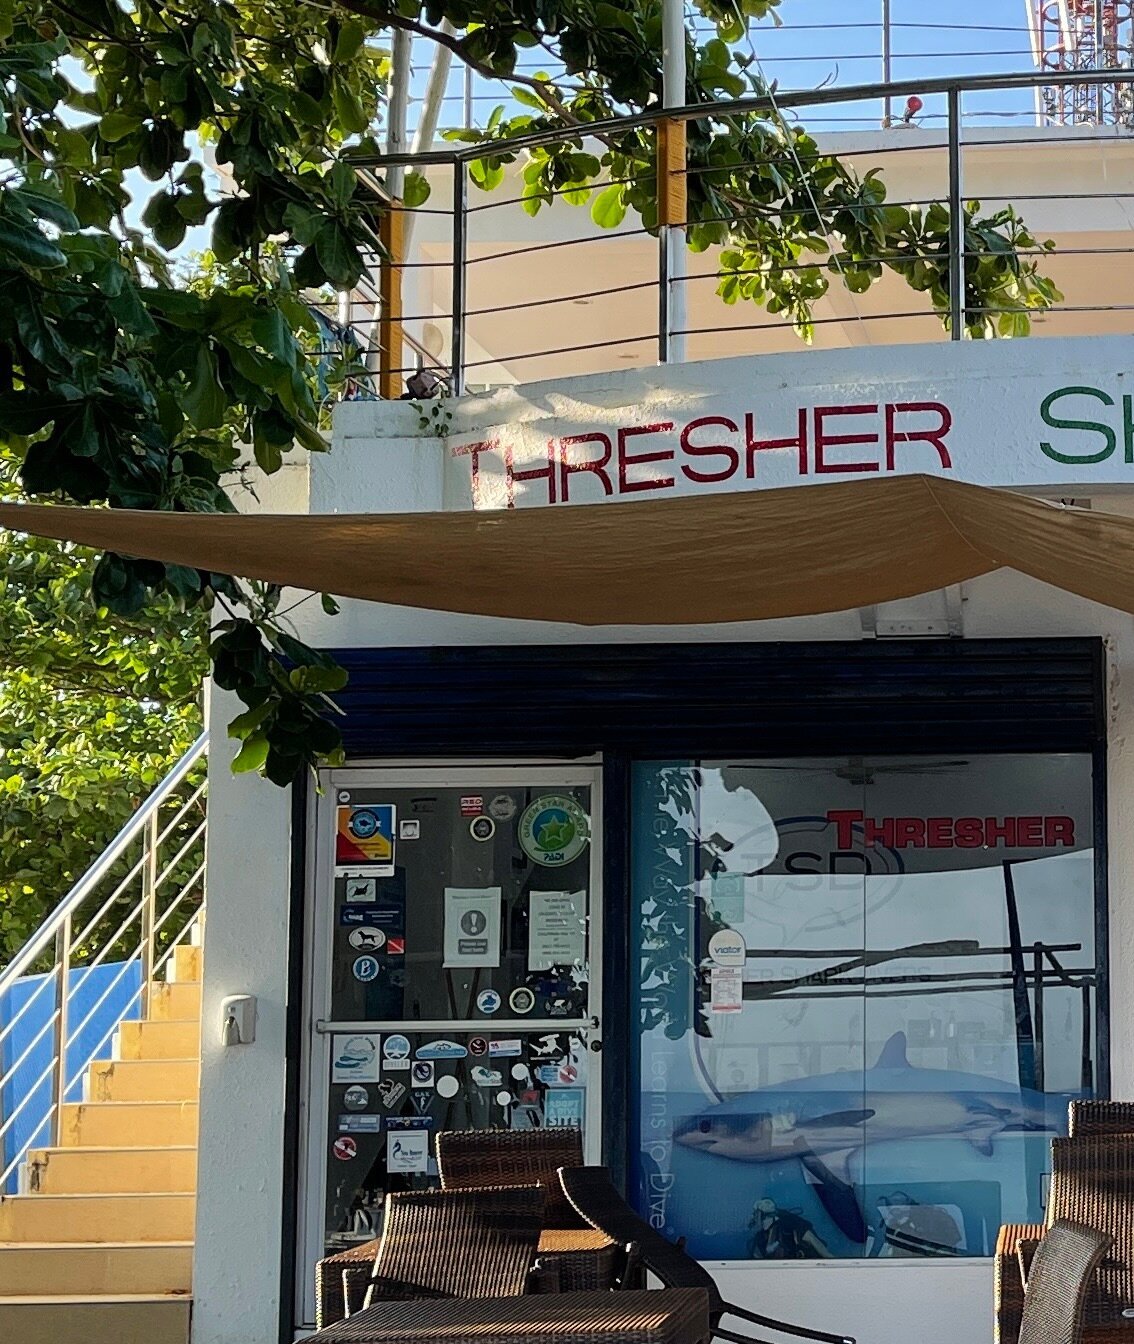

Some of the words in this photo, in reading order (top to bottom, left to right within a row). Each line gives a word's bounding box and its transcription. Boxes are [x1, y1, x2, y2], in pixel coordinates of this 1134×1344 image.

[452, 400, 953, 509] THRESHER
[826, 809, 1075, 850] THRESHER
[543, 852, 565, 861] PADI
[650, 1051, 675, 1128] Learns
[549, 1116, 578, 1126] SITE
[651, 1139, 673, 1162] to
